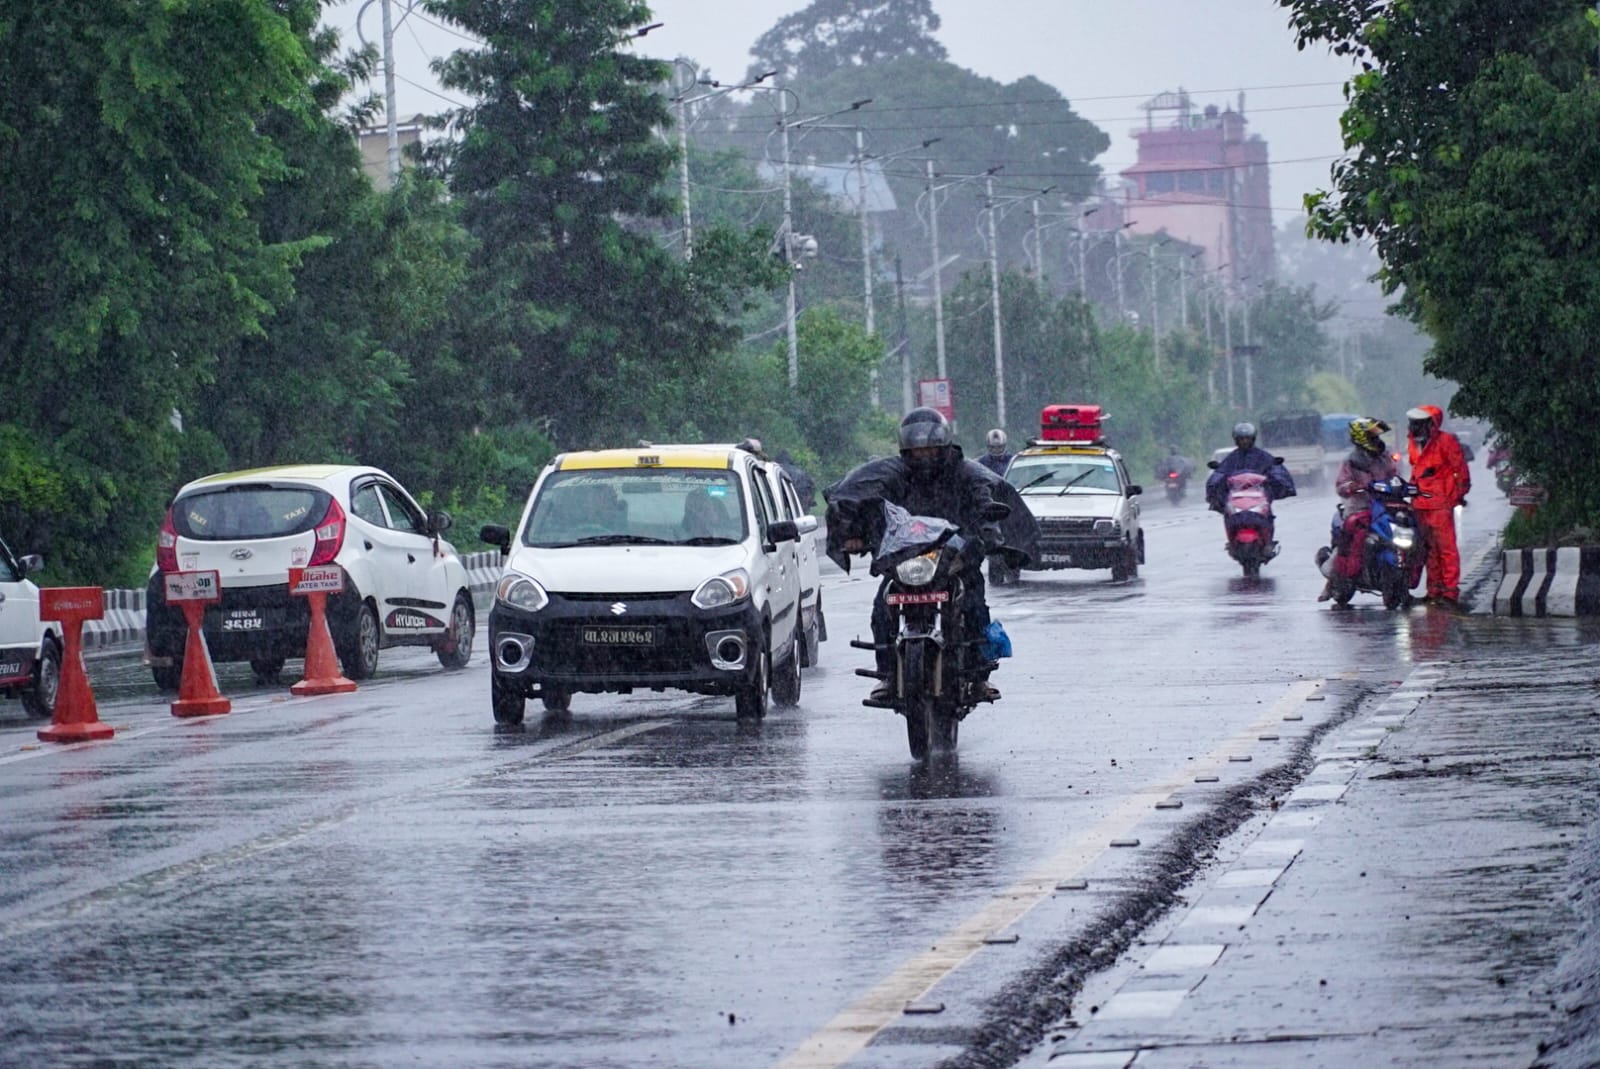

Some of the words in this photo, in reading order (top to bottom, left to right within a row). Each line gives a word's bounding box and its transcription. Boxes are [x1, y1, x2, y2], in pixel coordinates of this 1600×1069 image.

[638, 455, 660, 464] TAXI
[284, 506, 306, 521] TAXI
[395, 613, 426, 627] HYUNDAI
